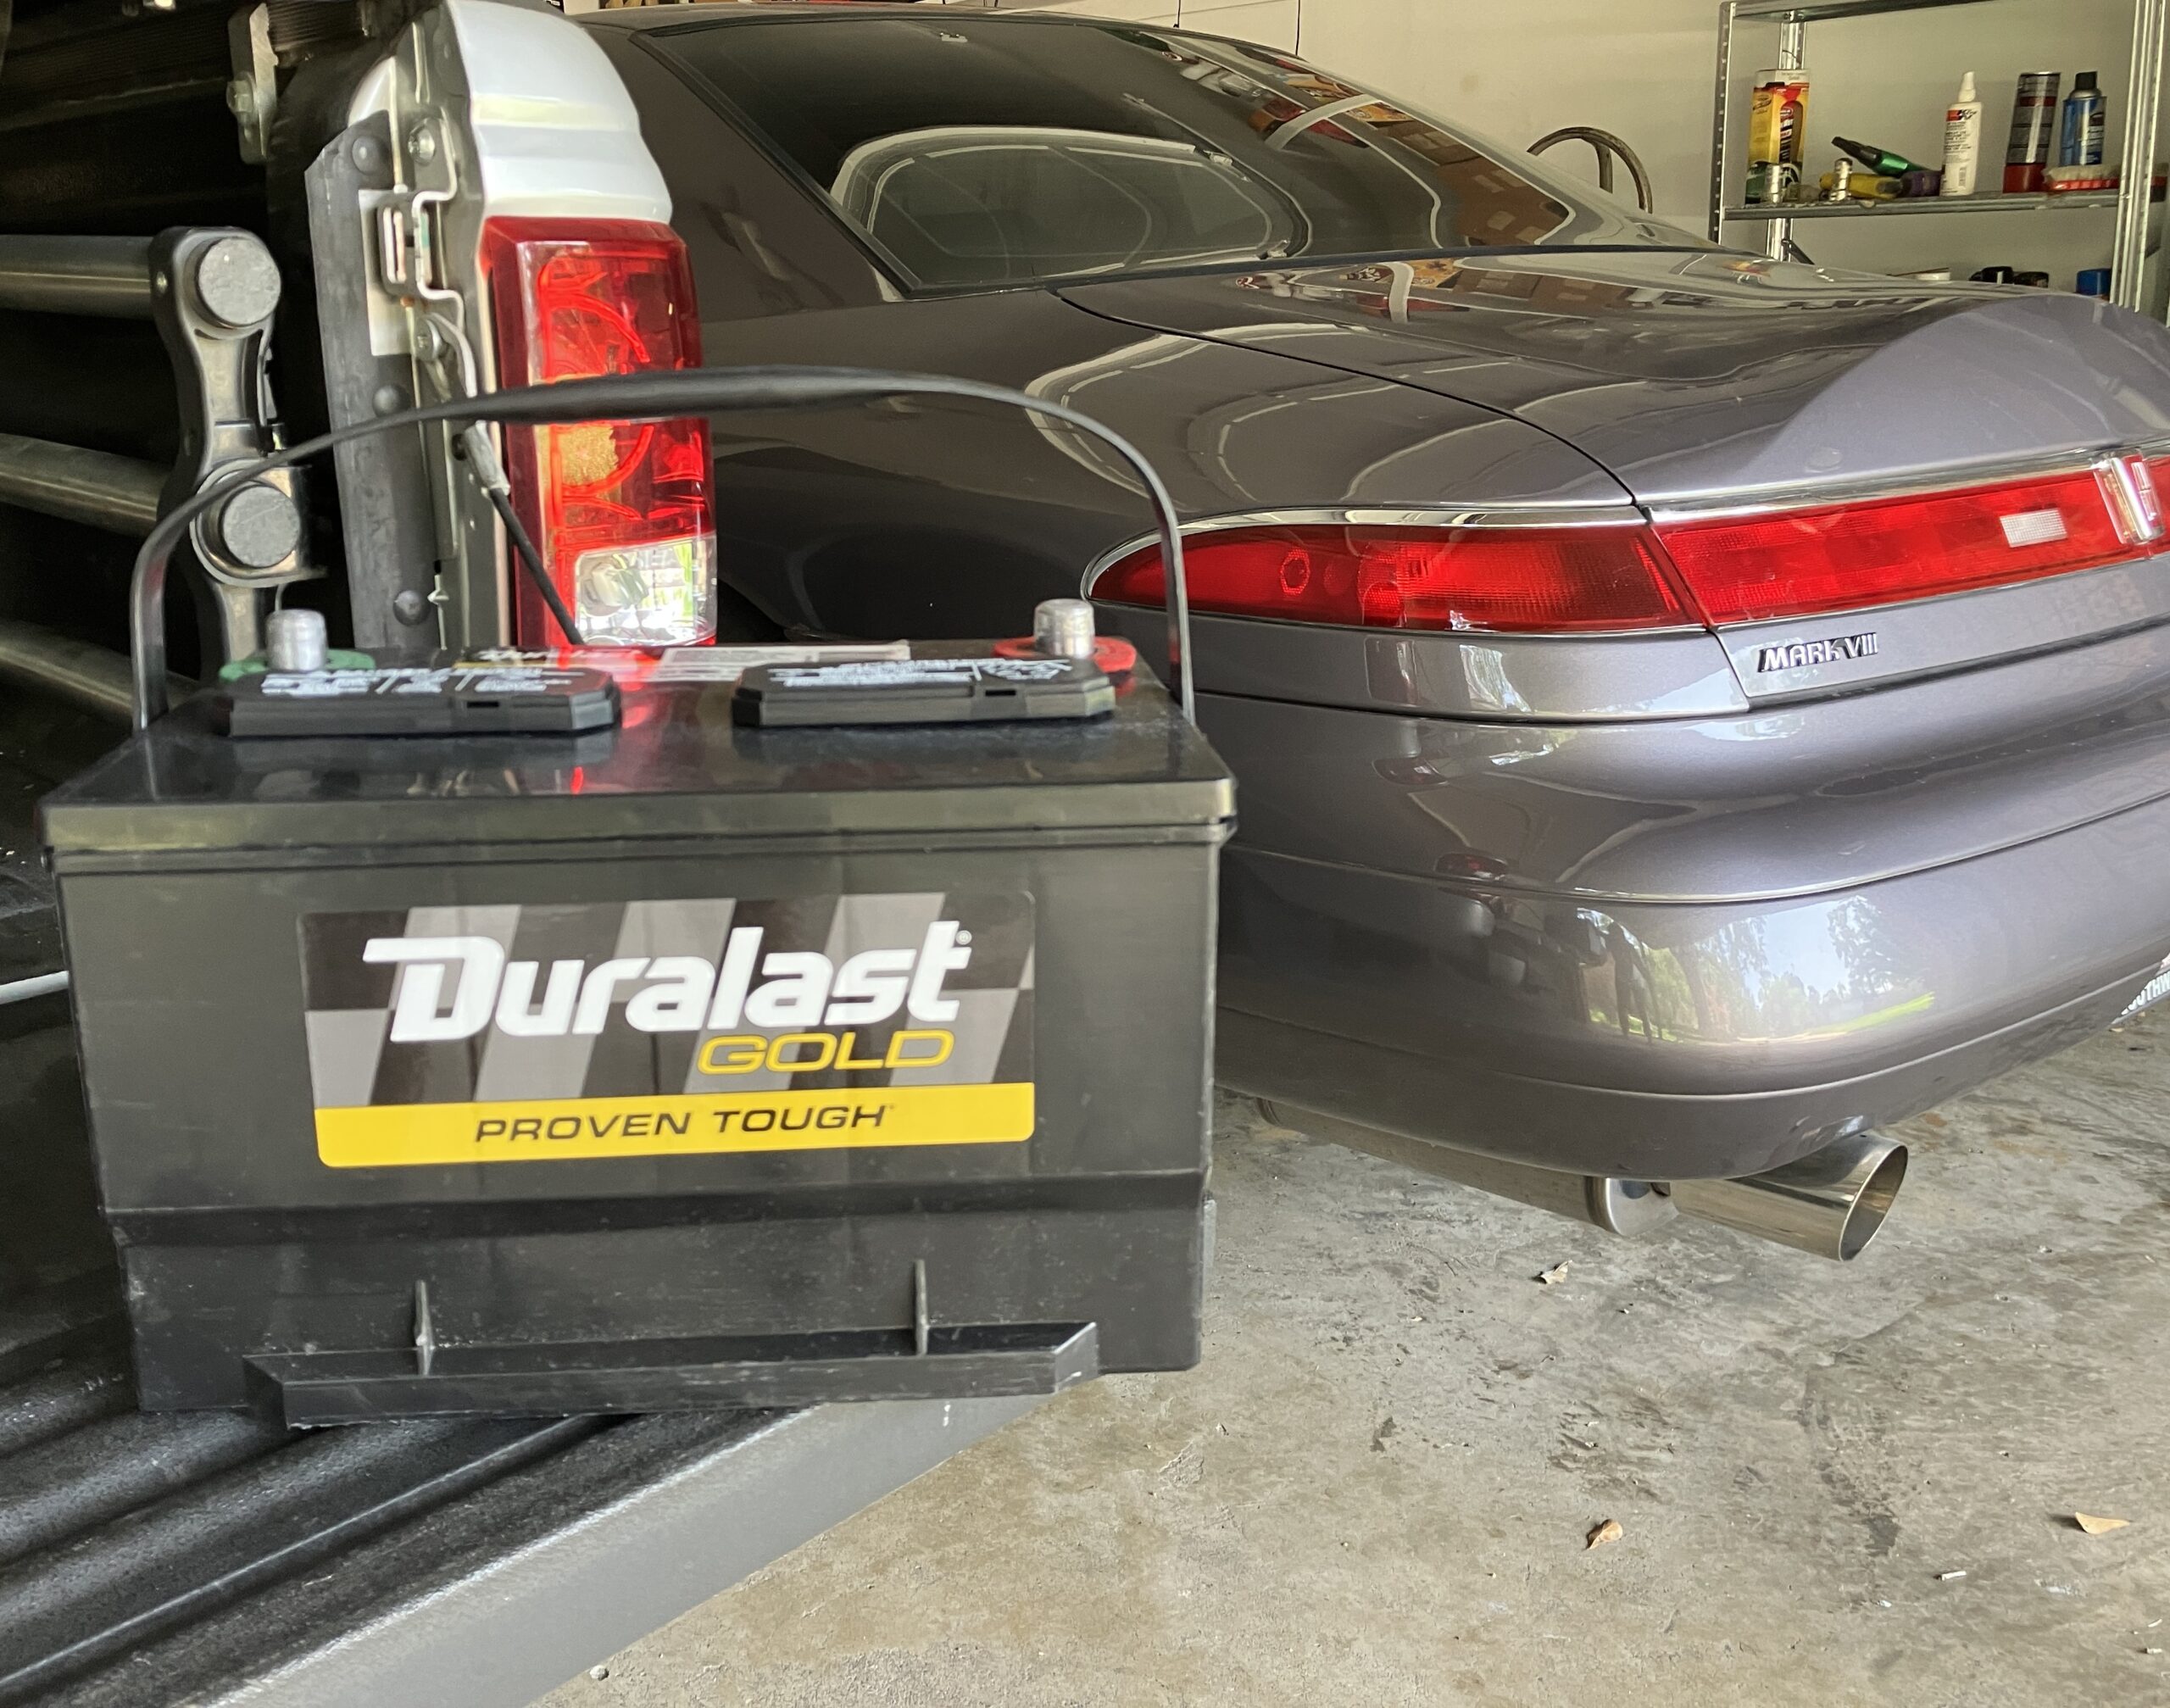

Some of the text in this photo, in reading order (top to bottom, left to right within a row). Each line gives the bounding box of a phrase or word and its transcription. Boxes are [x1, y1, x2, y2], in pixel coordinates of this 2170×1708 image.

[1758, 632, 1878, 672] MARK VIII
[362, 921, 972, 1043] Duralast
[2122, 971, 2170, 1015] UTHW
[698, 1030, 954, 1074] GOLD
[476, 1105, 886, 1142] PROVEN TOUGH
